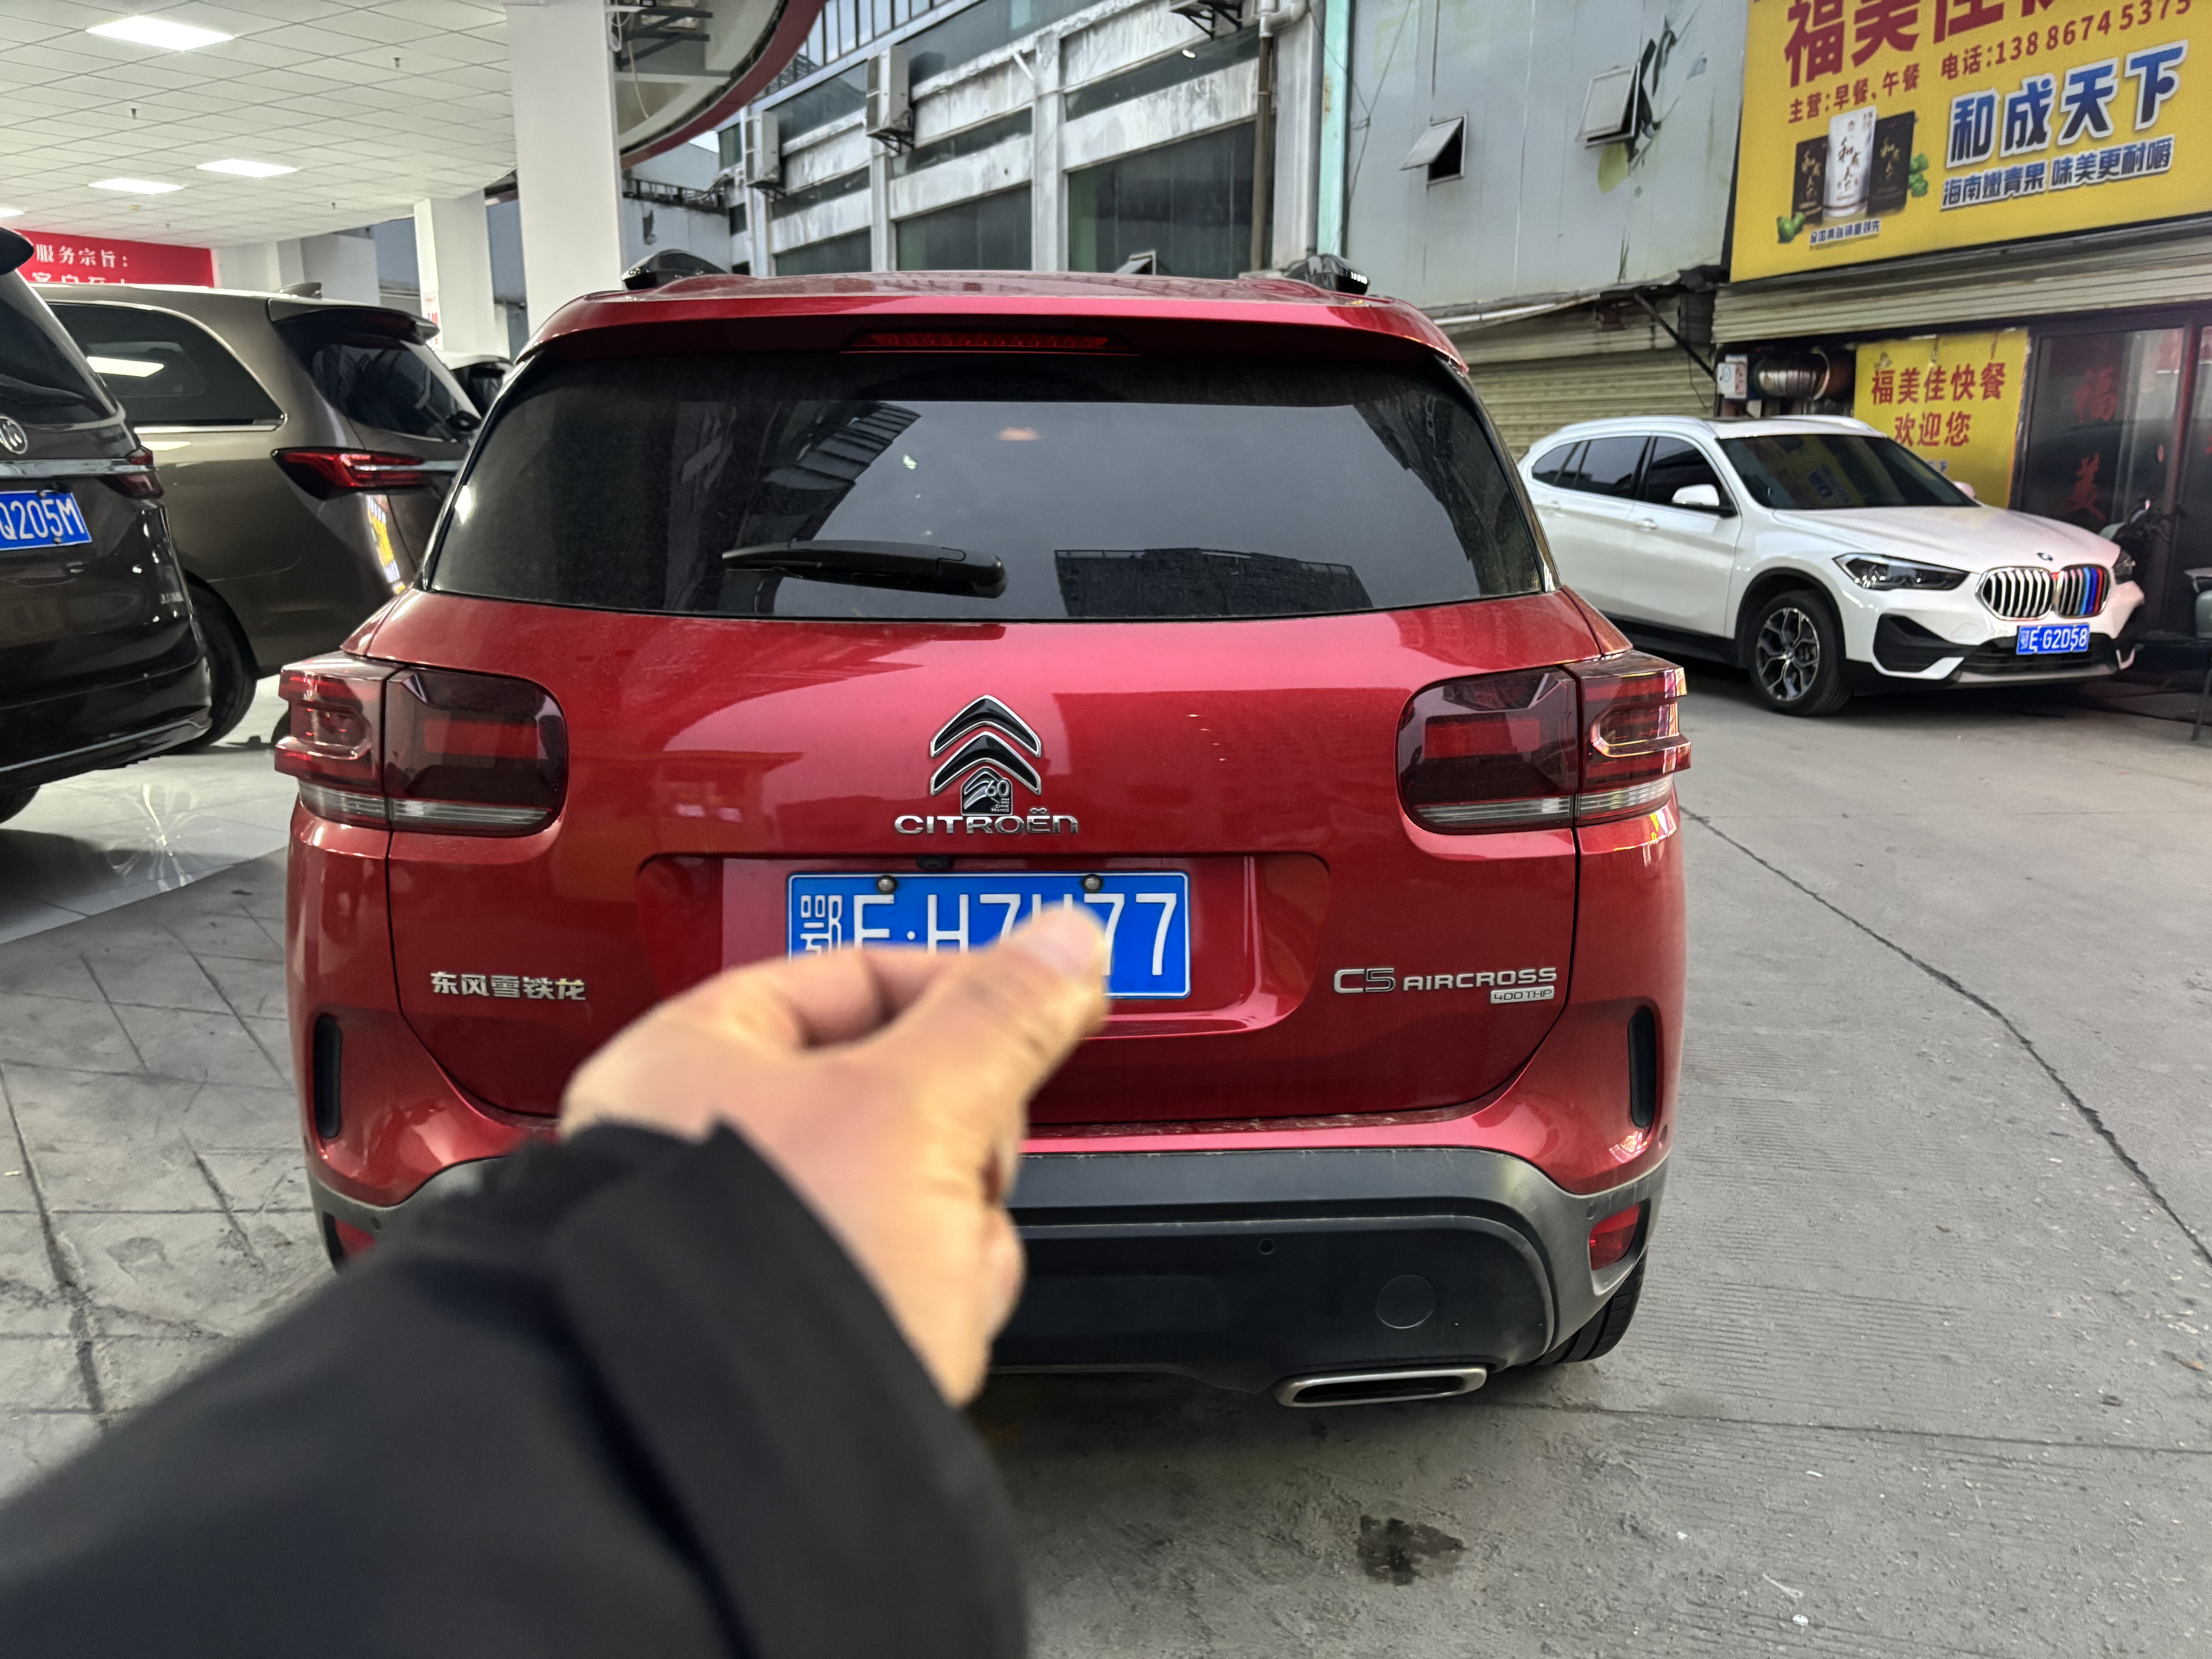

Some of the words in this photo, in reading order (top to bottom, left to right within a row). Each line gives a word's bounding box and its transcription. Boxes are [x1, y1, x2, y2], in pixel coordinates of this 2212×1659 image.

[1948, 40, 2188, 167] 和成天下
[1871, 362, 2006, 405] 福美佳快餐
[1894, 410, 1972, 447] 欢迎您
[985, 780, 1010, 797] 60
[800, 893, 1177, 975] 鄂E·H777
[431, 971, 586, 1001] 东风雪铁龙
[1334, 968, 1395, 994] C5
[1403, 967, 1557, 991] AIRCROSS
